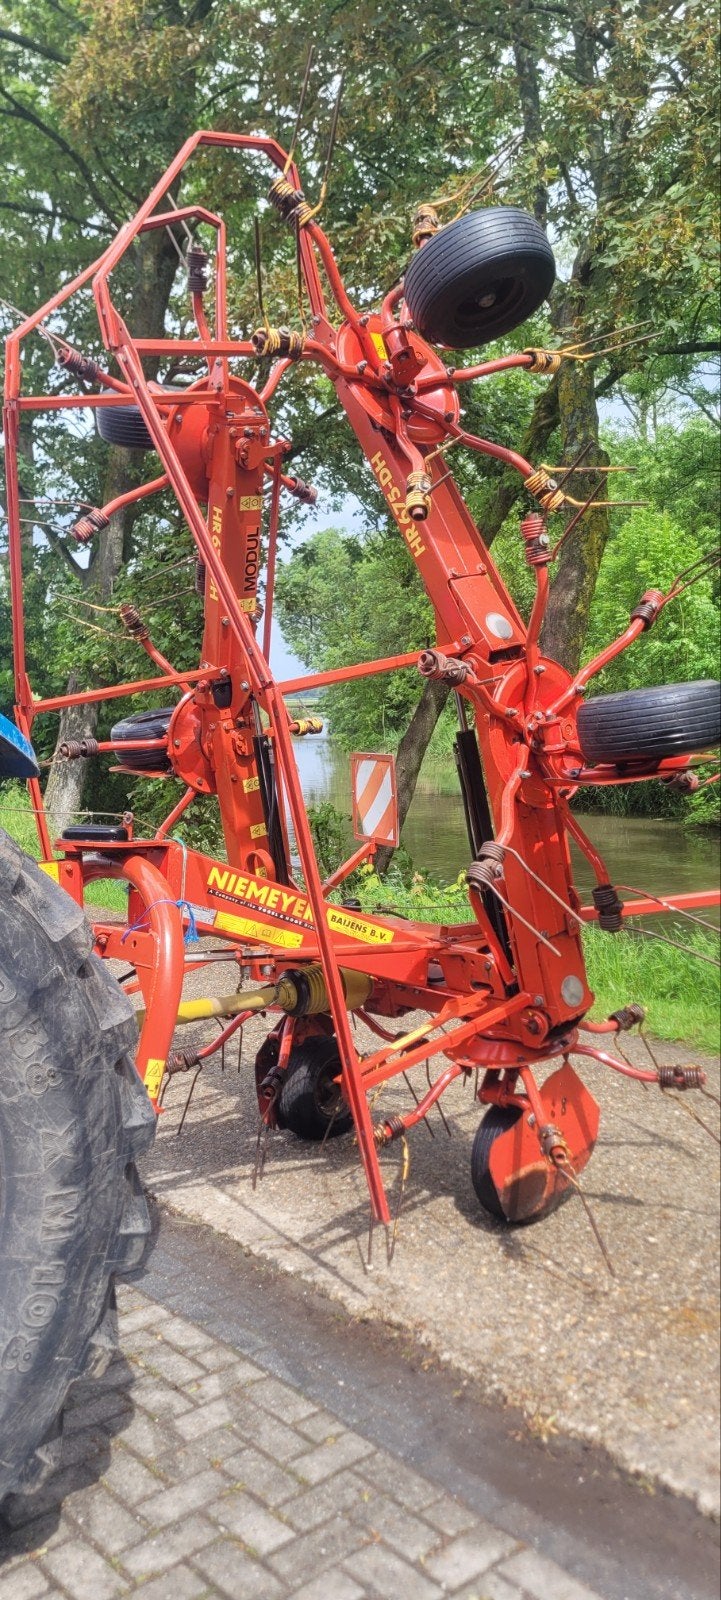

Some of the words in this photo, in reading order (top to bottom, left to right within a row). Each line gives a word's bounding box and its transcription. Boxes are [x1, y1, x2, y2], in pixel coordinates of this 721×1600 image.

[371, 451, 411, 524] 675-DH
[212, 506, 223, 534] HR
[405, 523, 426, 558] HR
[244, 527, 260, 592] MODUL
[330, 914, 367, 934] BAIJENS
[370, 928, 387, 941] B.V.
